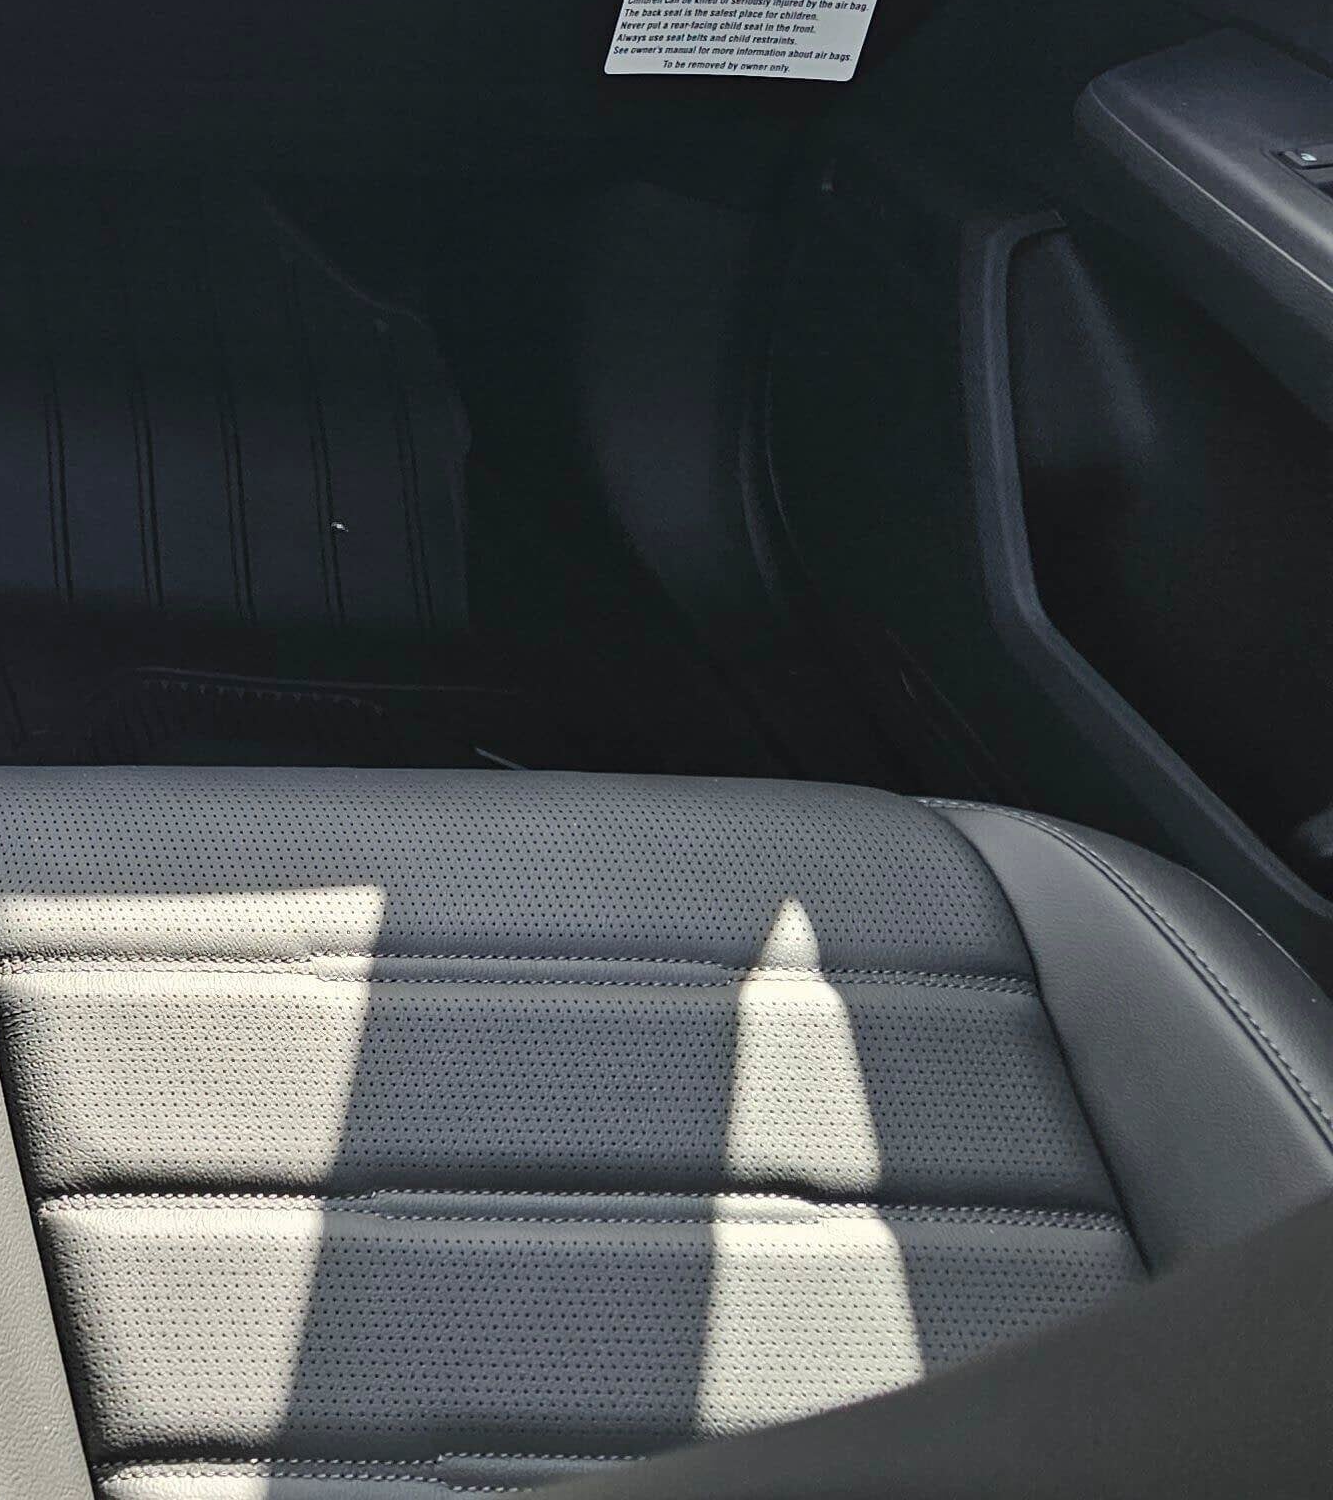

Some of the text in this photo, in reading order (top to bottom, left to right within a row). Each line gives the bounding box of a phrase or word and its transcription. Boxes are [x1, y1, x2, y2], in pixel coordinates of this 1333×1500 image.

[805, 0, 818, 10] by
[818, 0, 833, 9] the
[834, 0, 848, 9] air
[849, 1, 870, 13] bag.
[624, 8, 819, 20] The back seat is the safest place for children.
[620, 21, 816, 33] Never put a rear-facing child seat in the front.
[616, 33, 797, 45] Always use seat belts and child restraints.
[613, 45, 629, 55] See
[630, 46, 663, 54] owner's
[664, 46, 697, 55] manual
[698, 46, 710, 55] for
[711, 47, 735, 55] more
[736, 47, 787, 58] information
[787, 50, 813, 59] about
[814, 51, 828, 60] air
[663, 60, 791, 73] To be removed by owner only.
